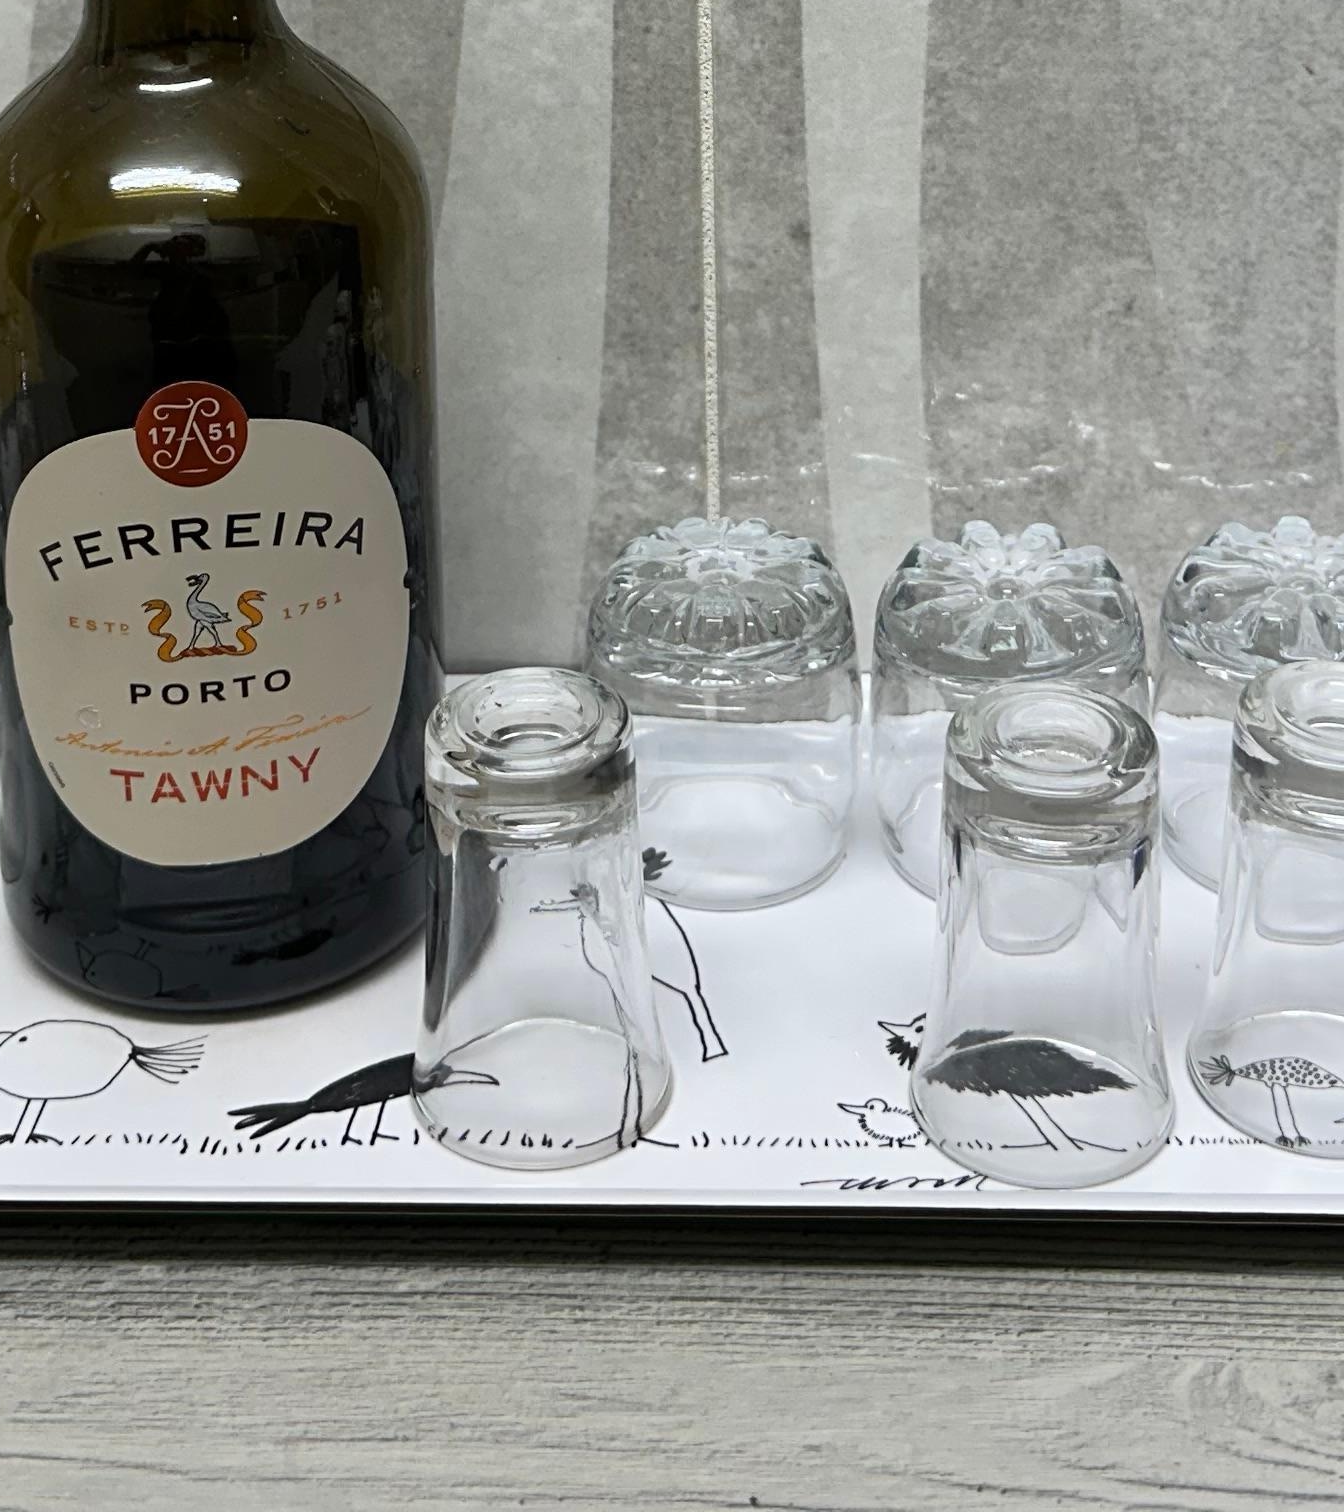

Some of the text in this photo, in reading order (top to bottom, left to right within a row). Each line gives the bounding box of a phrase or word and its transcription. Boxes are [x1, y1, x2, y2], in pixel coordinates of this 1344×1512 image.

[39, 511, 364, 582] FERREIRA
[282, 591, 343, 620] 1751
[129, 669, 291, 705] PORTO
[109, 747, 321, 804] TAWNY
